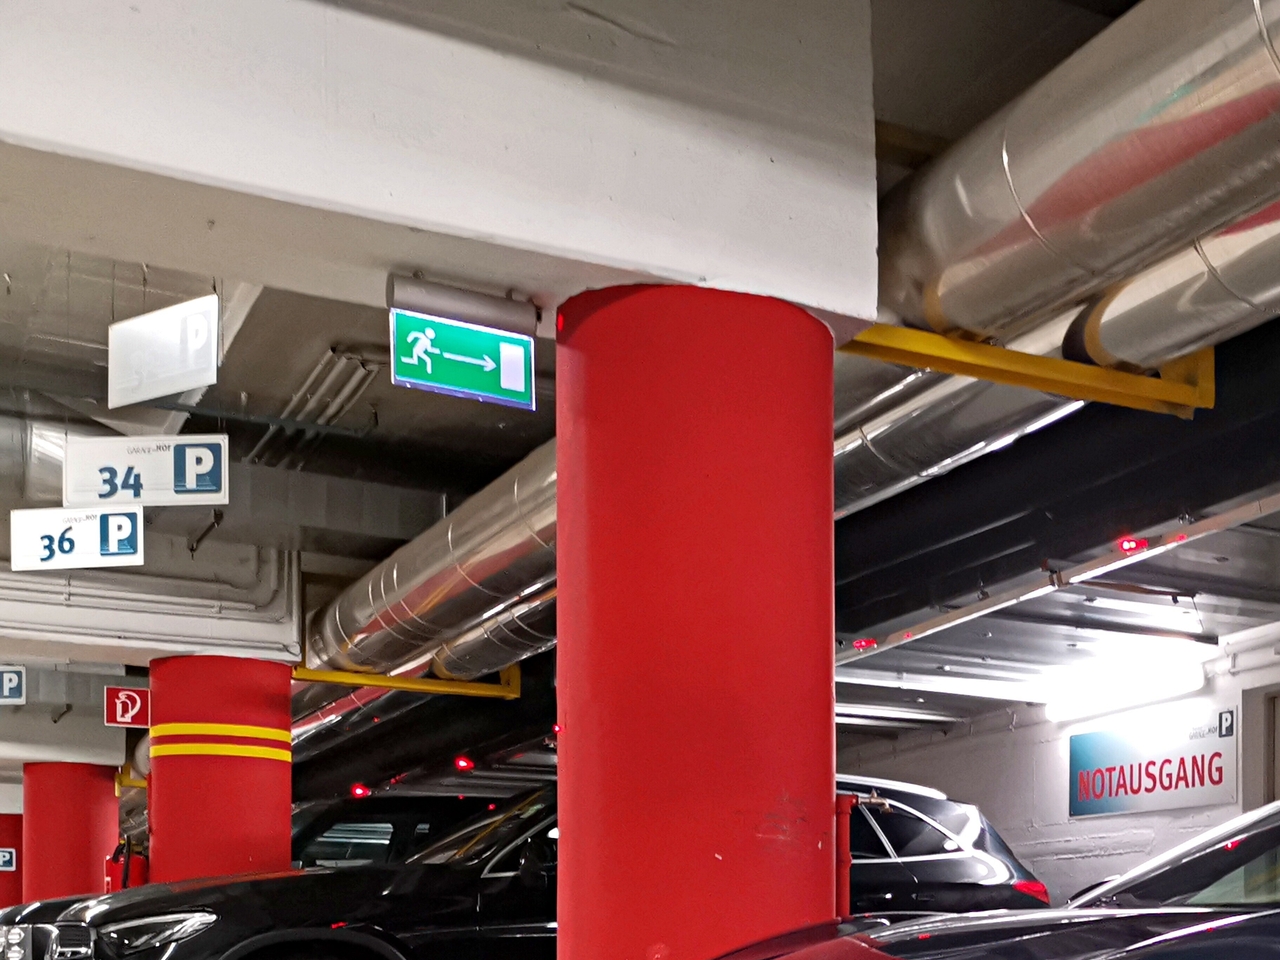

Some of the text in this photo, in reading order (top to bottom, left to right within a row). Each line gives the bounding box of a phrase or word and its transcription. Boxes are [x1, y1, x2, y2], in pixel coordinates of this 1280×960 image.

[98, 466, 143, 499] 34
[185, 446, 214, 490] P
[40, 525, 75, 562] 36
[108, 514, 132, 552] P
[3, 672, 19, 696] P
[1222, 712, 1232, 735] P
[1077, 751, 1224, 802] NOTAUSGANG
